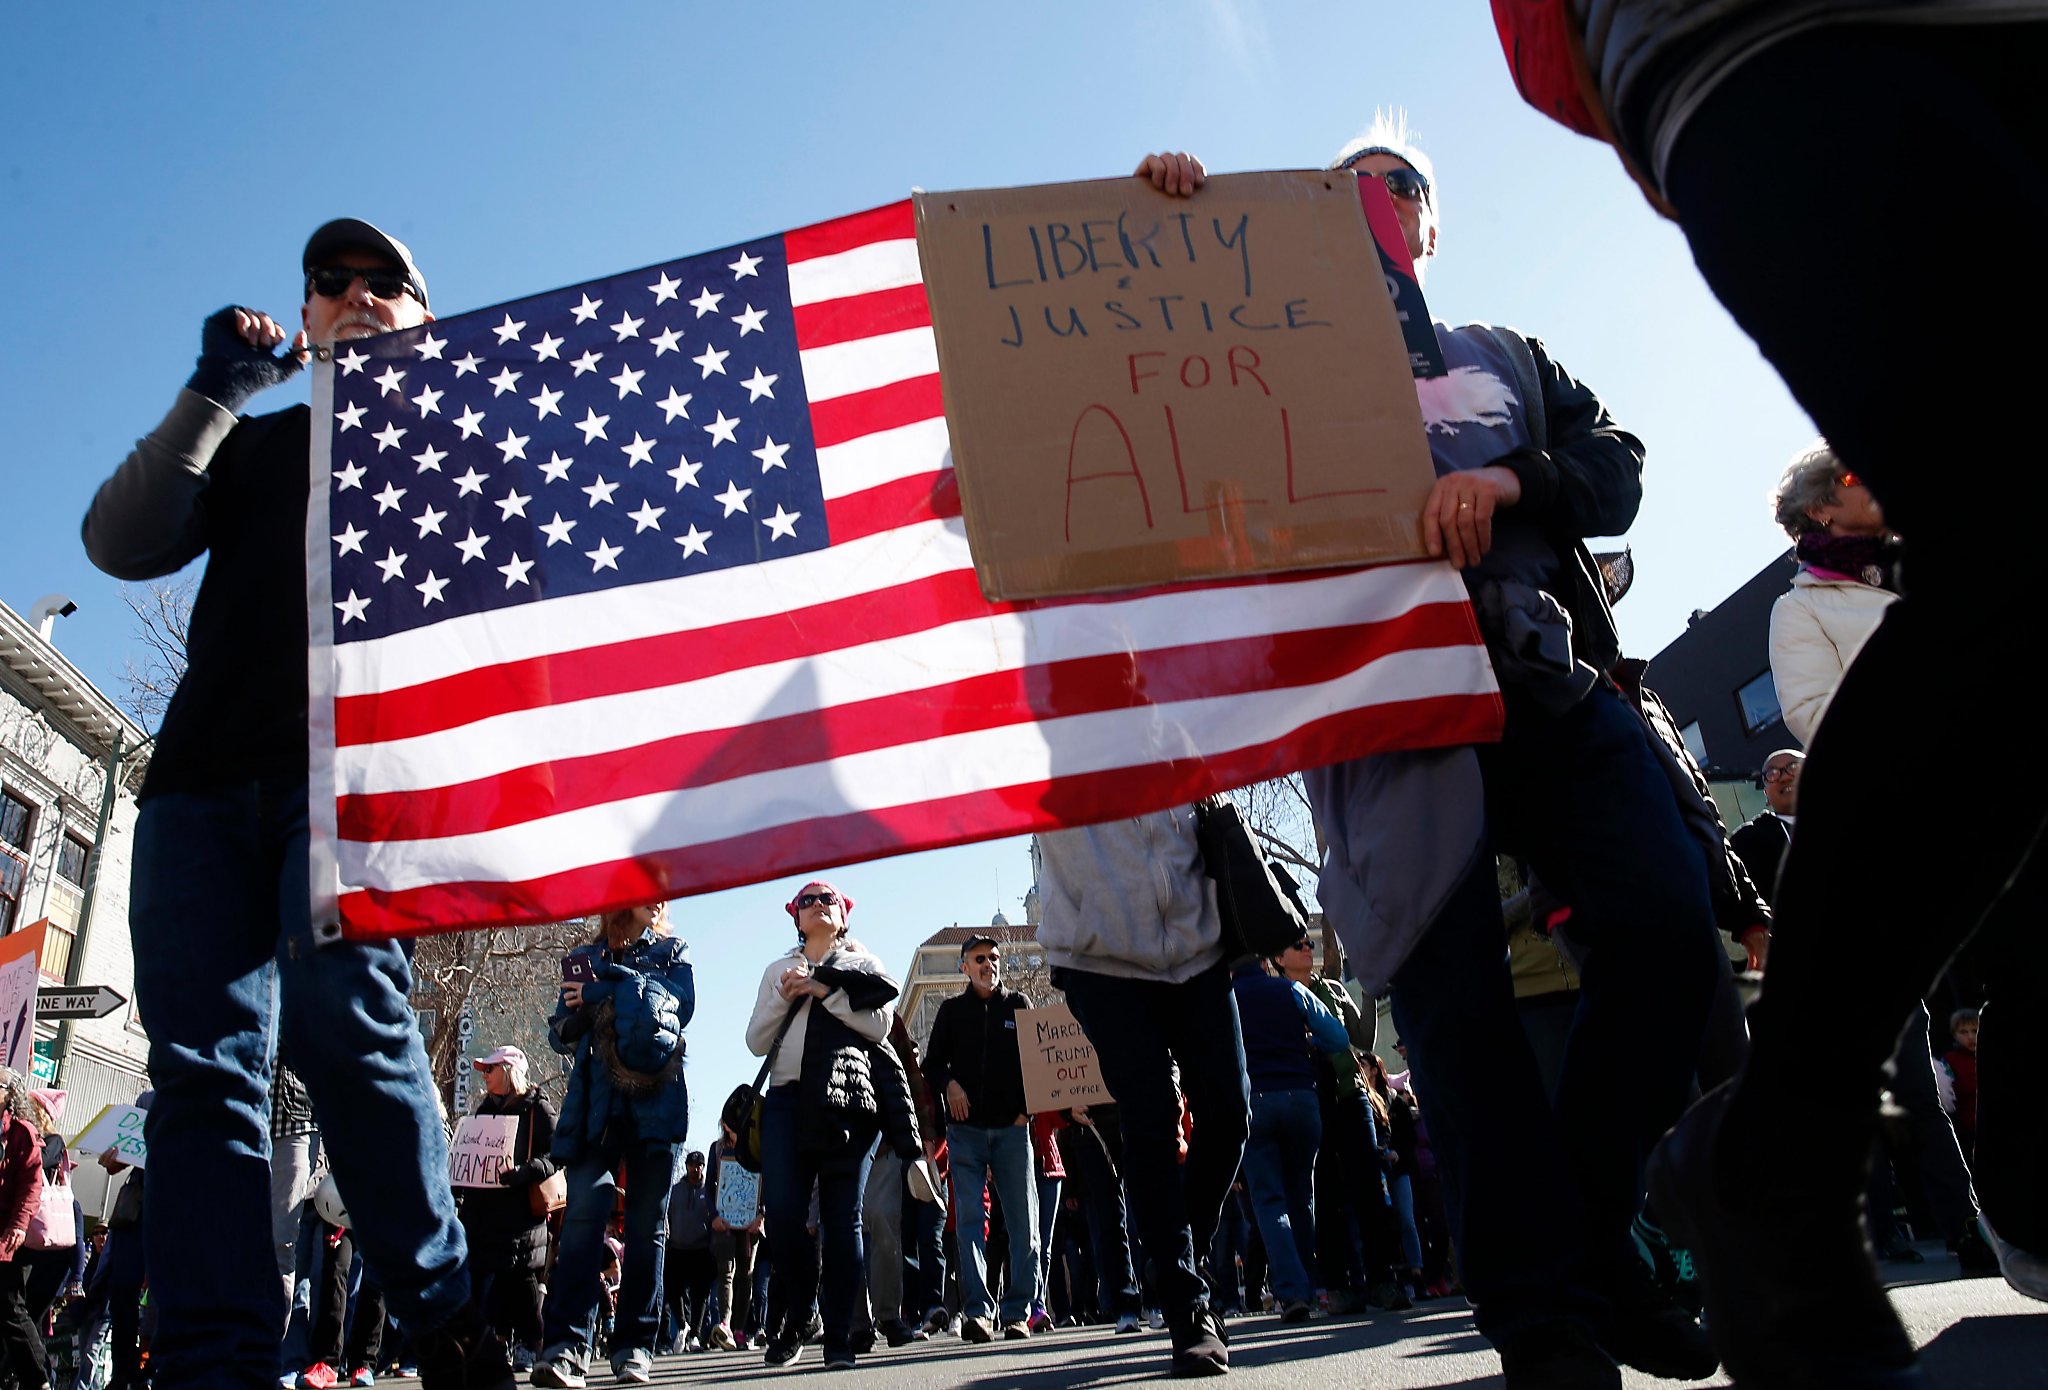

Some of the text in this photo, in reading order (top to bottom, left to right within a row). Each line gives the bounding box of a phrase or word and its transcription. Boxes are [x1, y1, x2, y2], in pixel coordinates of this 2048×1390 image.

[982, 211, 1251, 298] LIBERTY
[1001, 296, 1333, 348] JUSTICE
[1128, 346, 1271, 396] FOR
[1065, 404, 1388, 543] ALL
[65, 996, 96, 1010] WAY
[1040, 1045, 1094, 1064] TRUMP
[1057, 1064, 1088, 1081] OUT
[1051, 1084, 1100, 1098] OF OFFICE
